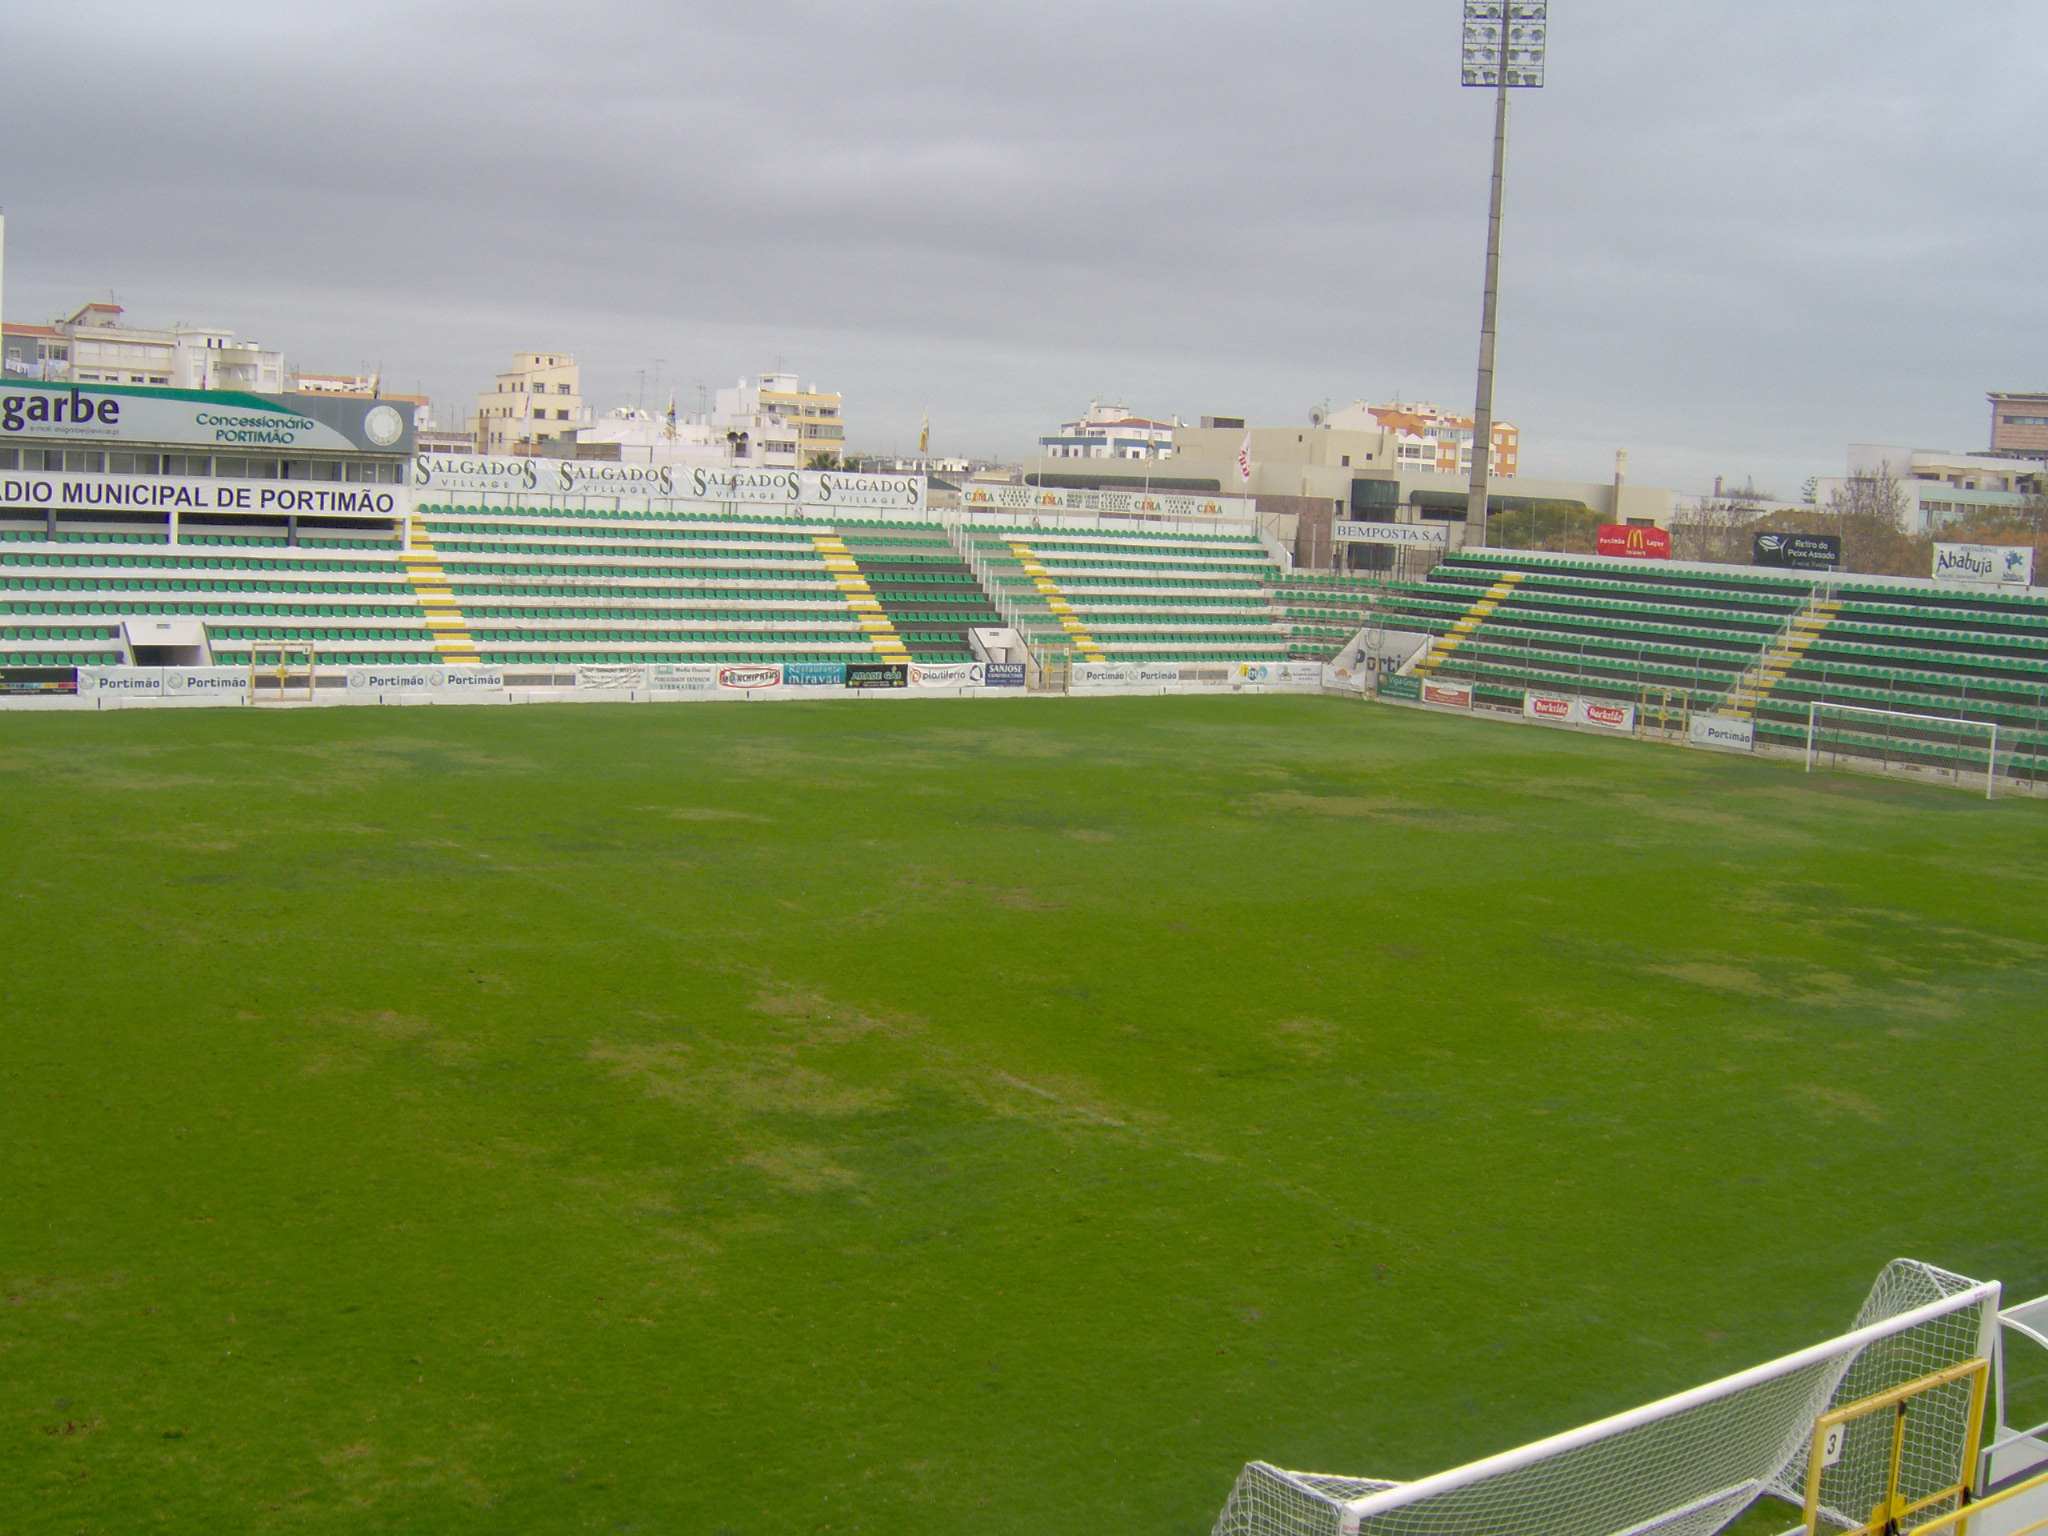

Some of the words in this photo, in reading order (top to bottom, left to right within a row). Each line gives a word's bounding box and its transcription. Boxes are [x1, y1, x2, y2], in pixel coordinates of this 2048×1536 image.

[2, 388, 119, 431] garbe
[196, 412, 314, 431] Concessionário
[216, 429, 294, 444] PORTIMÃO
[415, 454, 537, 490] SALGADOS
[560, 461, 673, 495] SALGADOS
[441, 479, 509, 488] VILLAGE
[583, 485, 647, 494] VILLAGE
[693, 467, 799, 500] SALGADOS
[819, 473, 919, 504] SALGADOS
[0, 480, 52, 502] DIO
[62, 482, 208, 507] MUNICIPAL
[217, 487, 251, 507] DE
[261, 489, 394, 512] PORTIMÃO
[716, 491, 775, 499] VILLAGE
[840, 495, 896, 504] VILLAGE
[964, 491, 994, 502] CIMA
[1034, 495, 1063, 506] CIMA
[1134, 499, 1161, 511] CIMA
[1197, 503, 1223, 514] CIMA
[1337, 525, 1418, 540] BEMPOSTA
[1808, 551, 1836, 560] Assado
[1354, 648, 1406, 673] Porti
[789, 665, 841, 673] Restaurante
[369, 675, 424, 686] Portimão
[448, 674, 501, 686] Portimão
[1086, 671, 1124, 680] Portimão
[1140, 671, 1177, 680] Portimão
[99, 677, 160, 689] Portimão
[187, 677, 247, 689] Portimão
[1707, 727, 1750, 743] Portimão
[1827, 1433, 1837, 1455] 3
